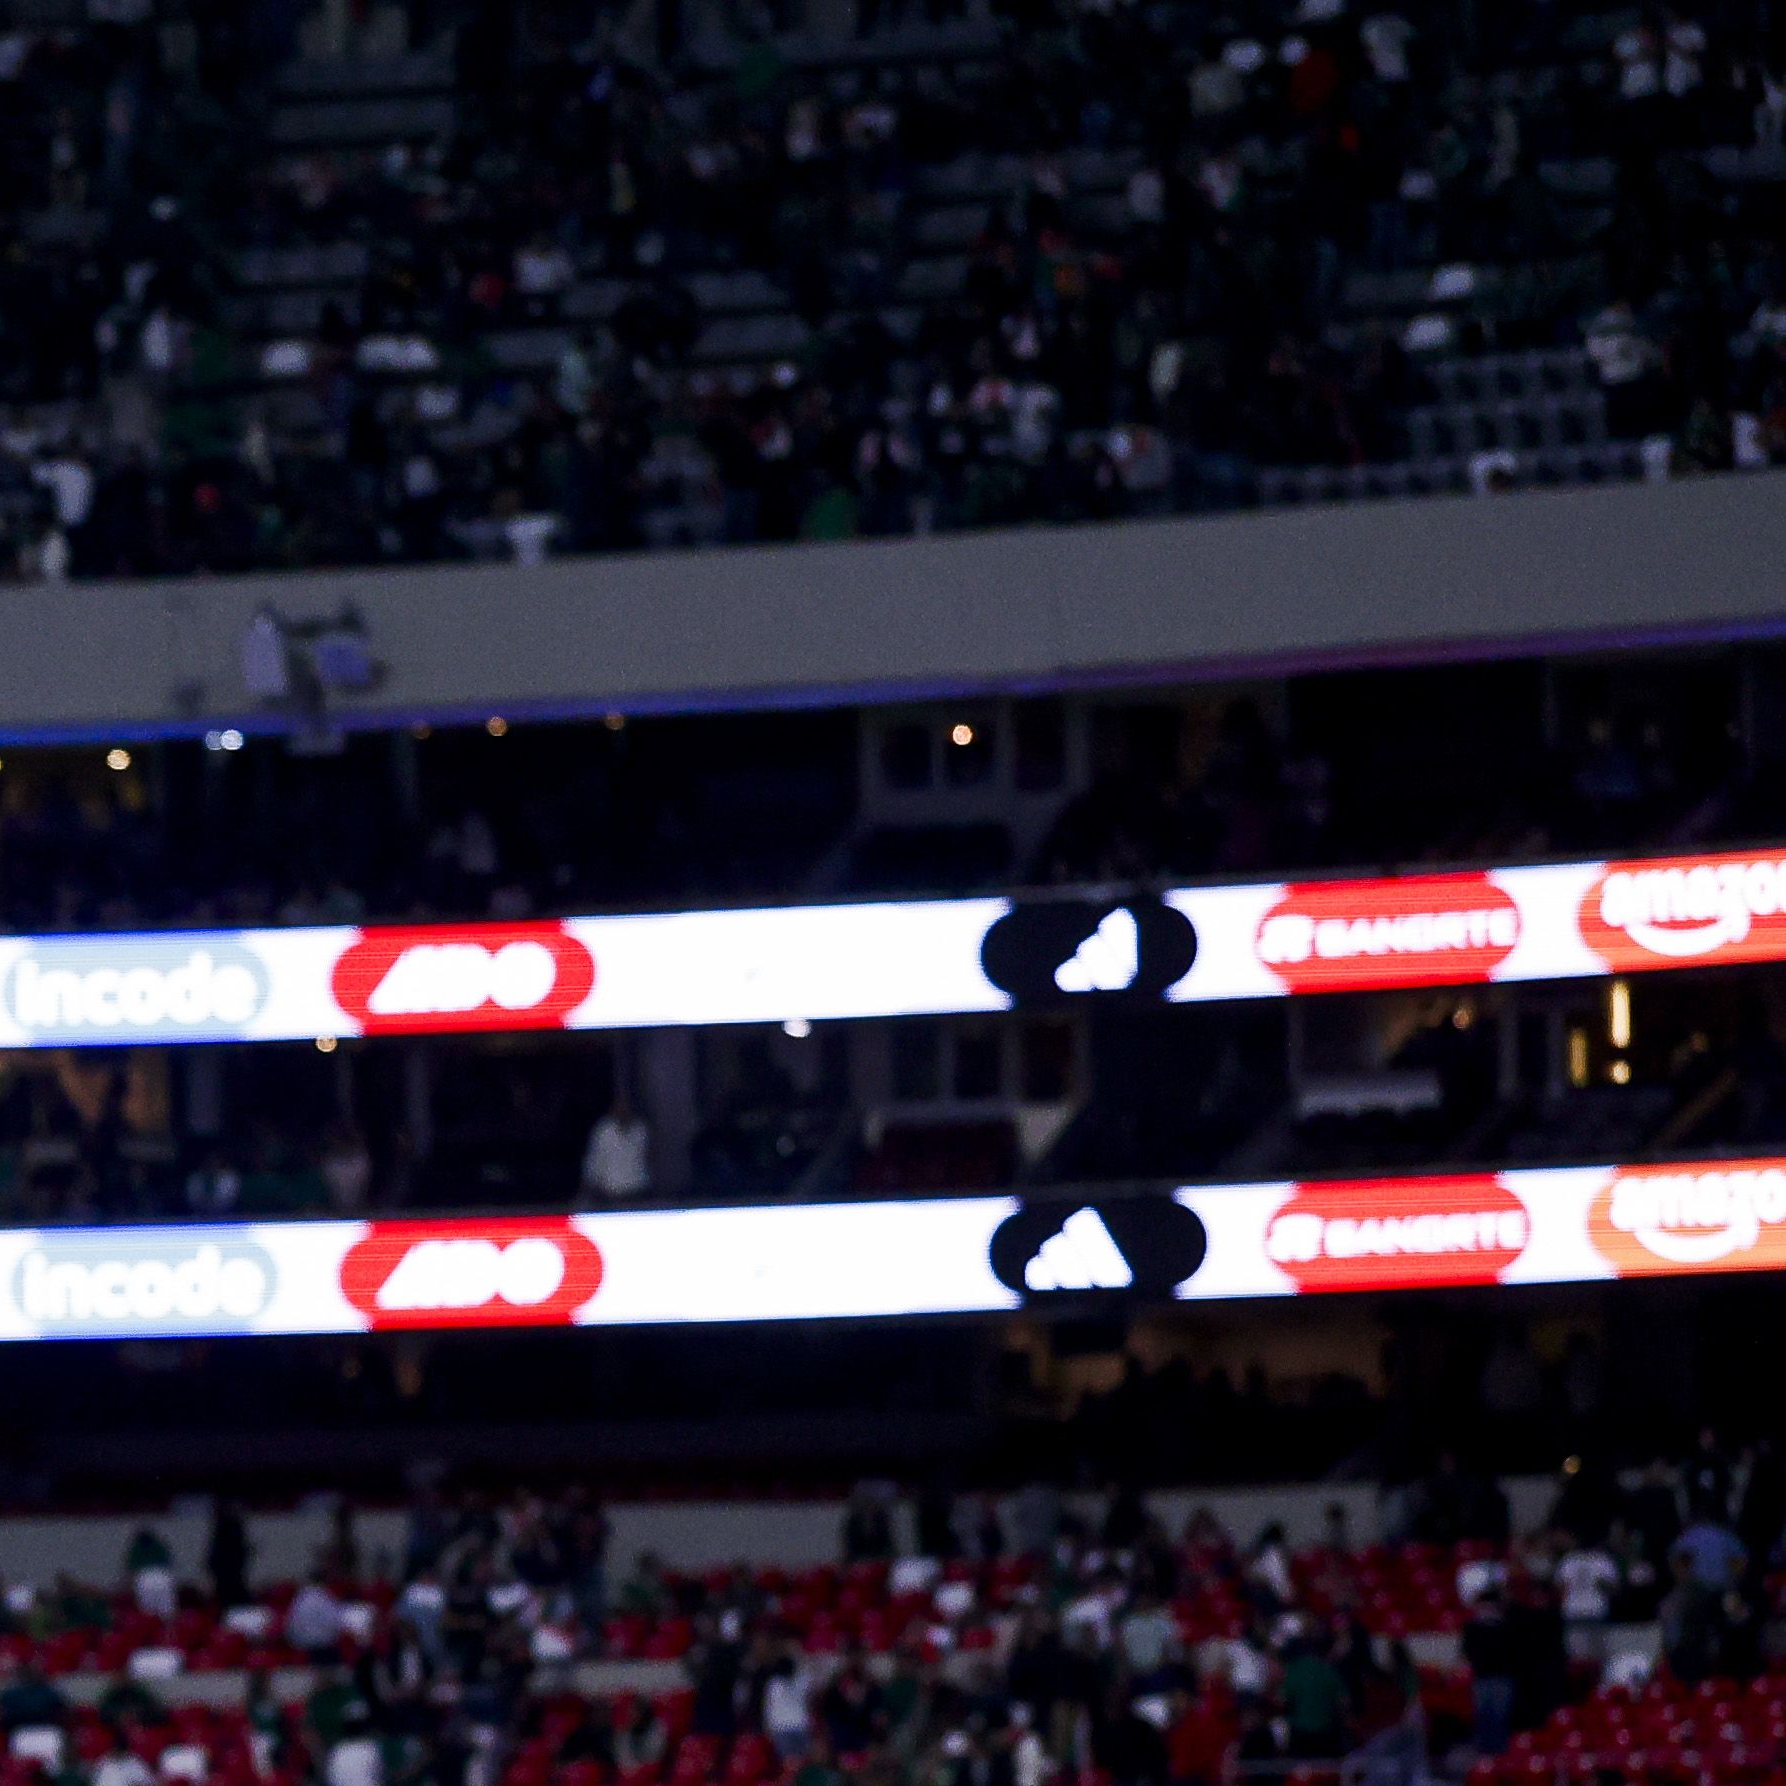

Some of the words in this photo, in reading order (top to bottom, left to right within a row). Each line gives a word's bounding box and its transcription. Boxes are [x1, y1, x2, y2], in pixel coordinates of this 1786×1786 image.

[1600, 861, 1786, 938] amazo
[15, 951, 257, 1026] incode
[21, 1244, 265, 1319] incode
